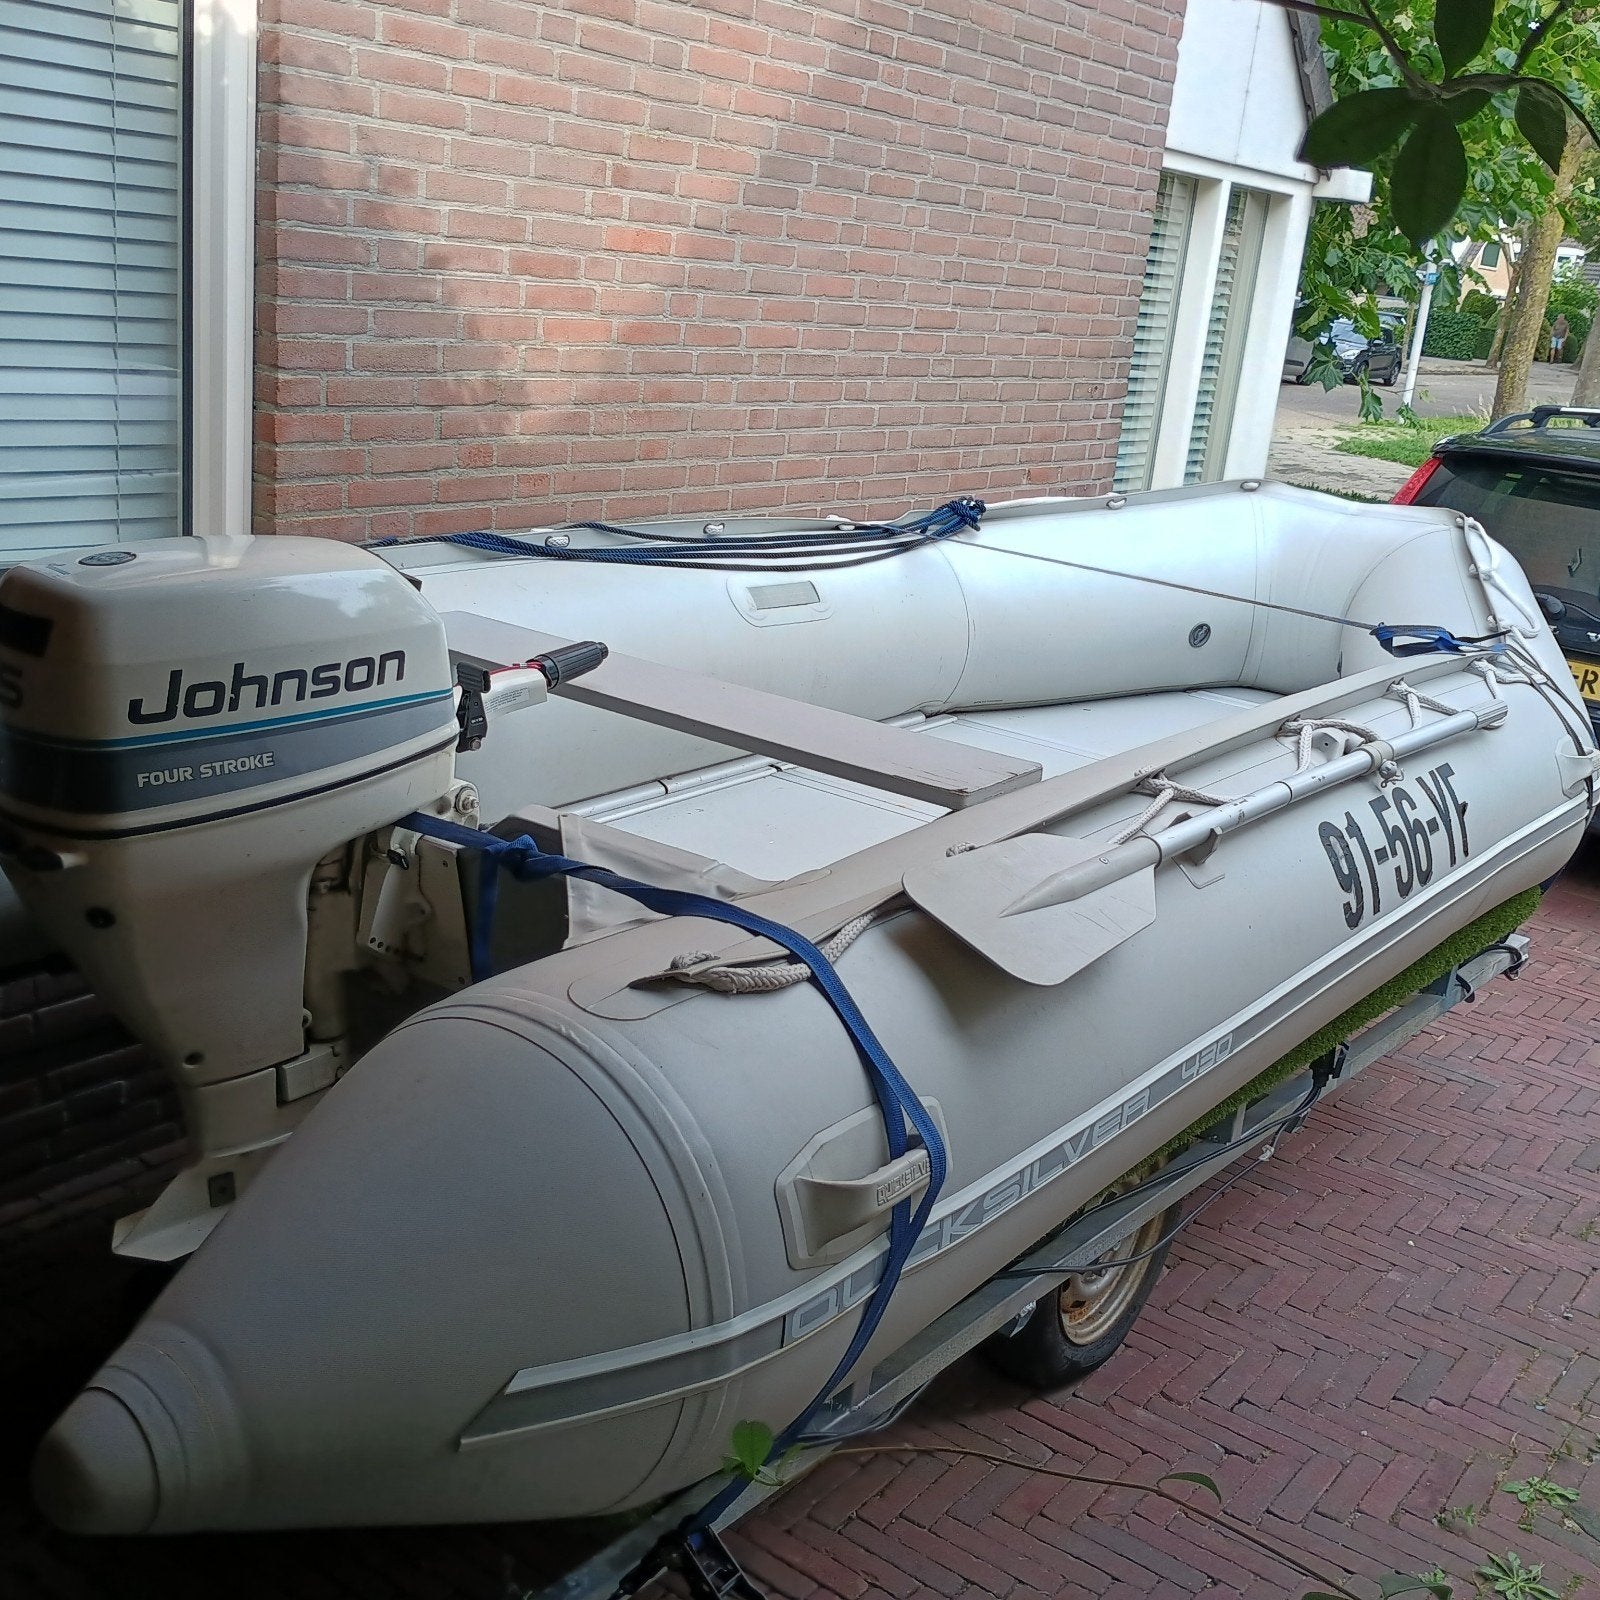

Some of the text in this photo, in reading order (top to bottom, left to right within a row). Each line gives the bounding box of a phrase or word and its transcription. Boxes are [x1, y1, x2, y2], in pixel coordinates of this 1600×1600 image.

[128, 650, 406, 725] Johnson
[137, 751, 275, 788] FOUR STROKE
[790, 1086, 1149, 1338] QUCKSILVER
